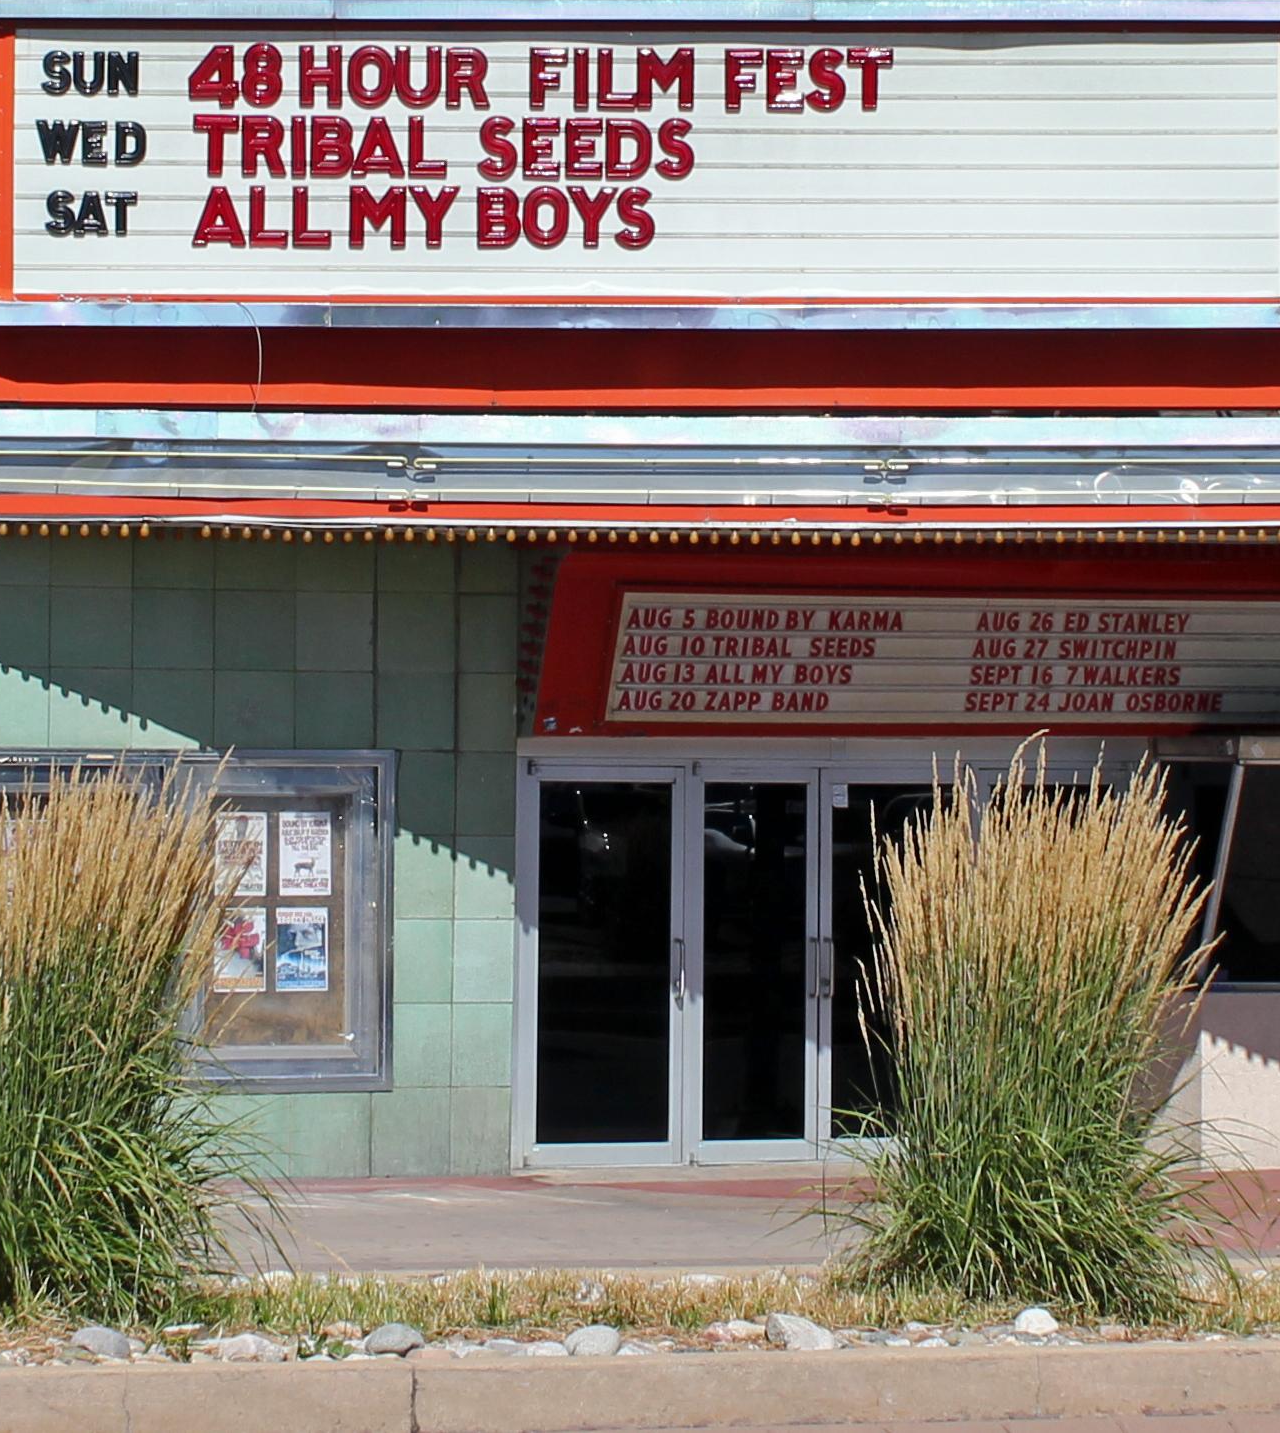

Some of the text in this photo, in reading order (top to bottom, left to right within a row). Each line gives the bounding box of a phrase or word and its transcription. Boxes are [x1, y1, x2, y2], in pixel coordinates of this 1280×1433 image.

[41, 42, 894, 113] SUN 48 HOUR FILM FEST
[35, 114, 695, 181] WED TRIBAL SEEDS
[45, 185, 656, 250] SAT ALL MY BOYS
[628, 609, 904, 631] AUG 5 BOUND BY KARMA
[977, 612, 1190, 633] AUG 26 ED STANLEY
[623, 636, 668, 656] AUG
[712, 636, 792, 657] TRIBAL
[809, 638, 877, 657] SEEDS
[973, 639, 1177, 660] AUG 27 SWITCHPIN
[621, 663, 853, 684] AUG 13 ALL MY BOYS
[969, 665, 1023, 686] SEPT
[1031, 666, 1054, 685] 16
[618, 691, 829, 711] AUG 20 ZAPP BAND
[964, 692, 1223, 713] SEPT 24 JOAN OSBORNE
